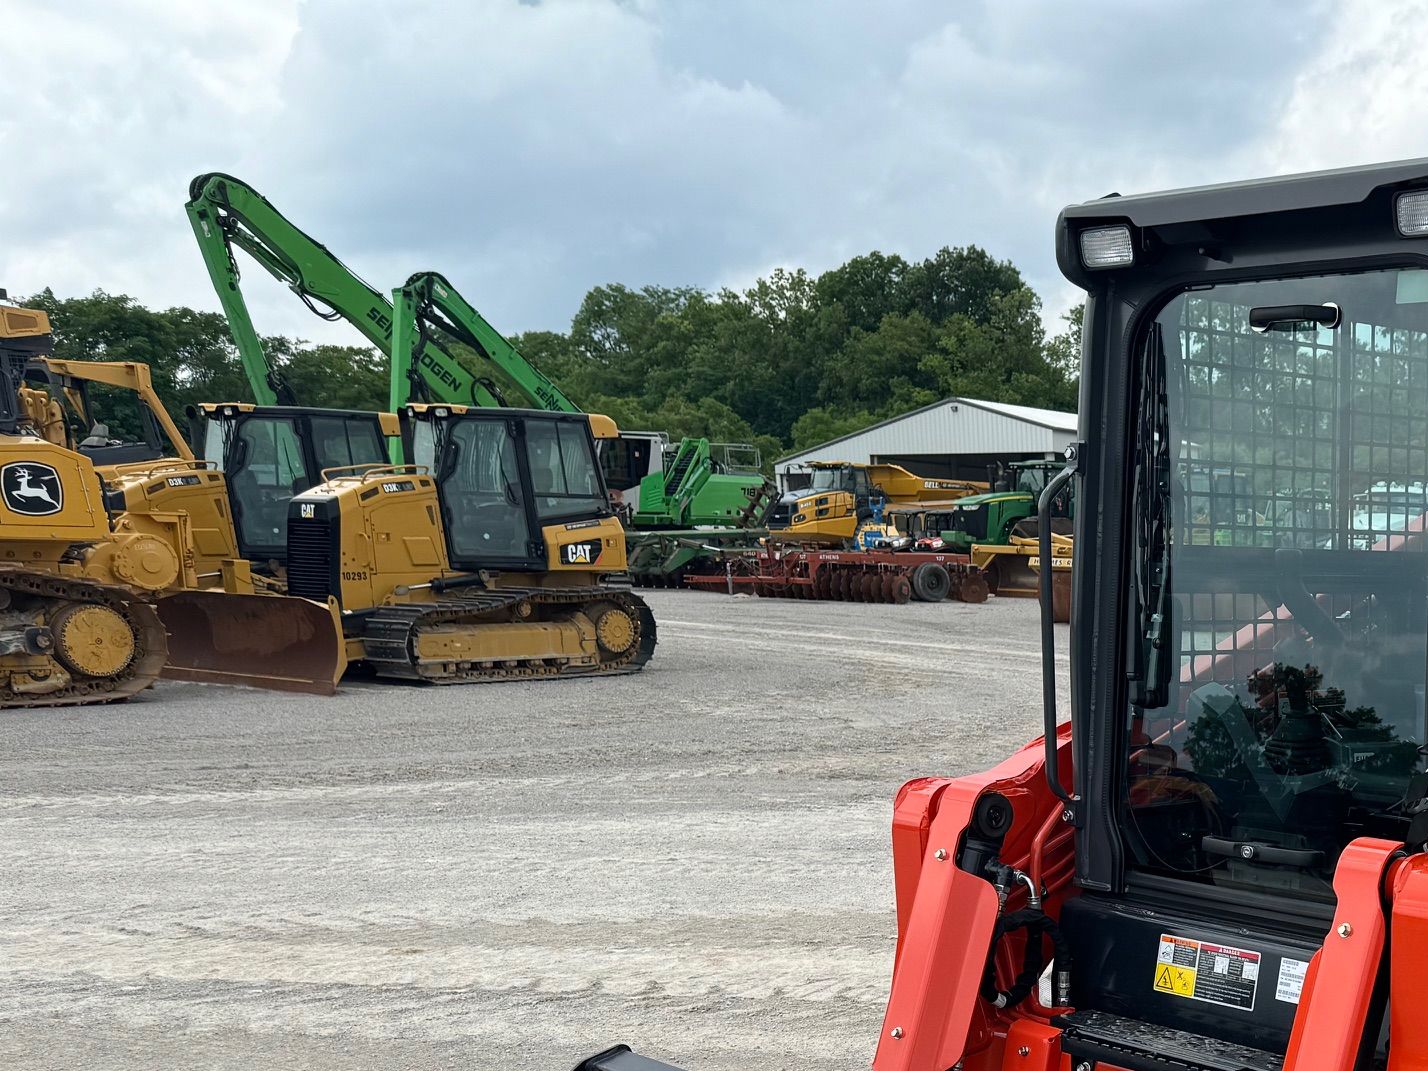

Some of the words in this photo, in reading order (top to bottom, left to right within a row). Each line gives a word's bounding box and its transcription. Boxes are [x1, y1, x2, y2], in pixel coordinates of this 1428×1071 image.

[301, 503, 315, 518] CAT
[567, 544, 591, 563] CAT
[342, 571, 368, 581] 10293
